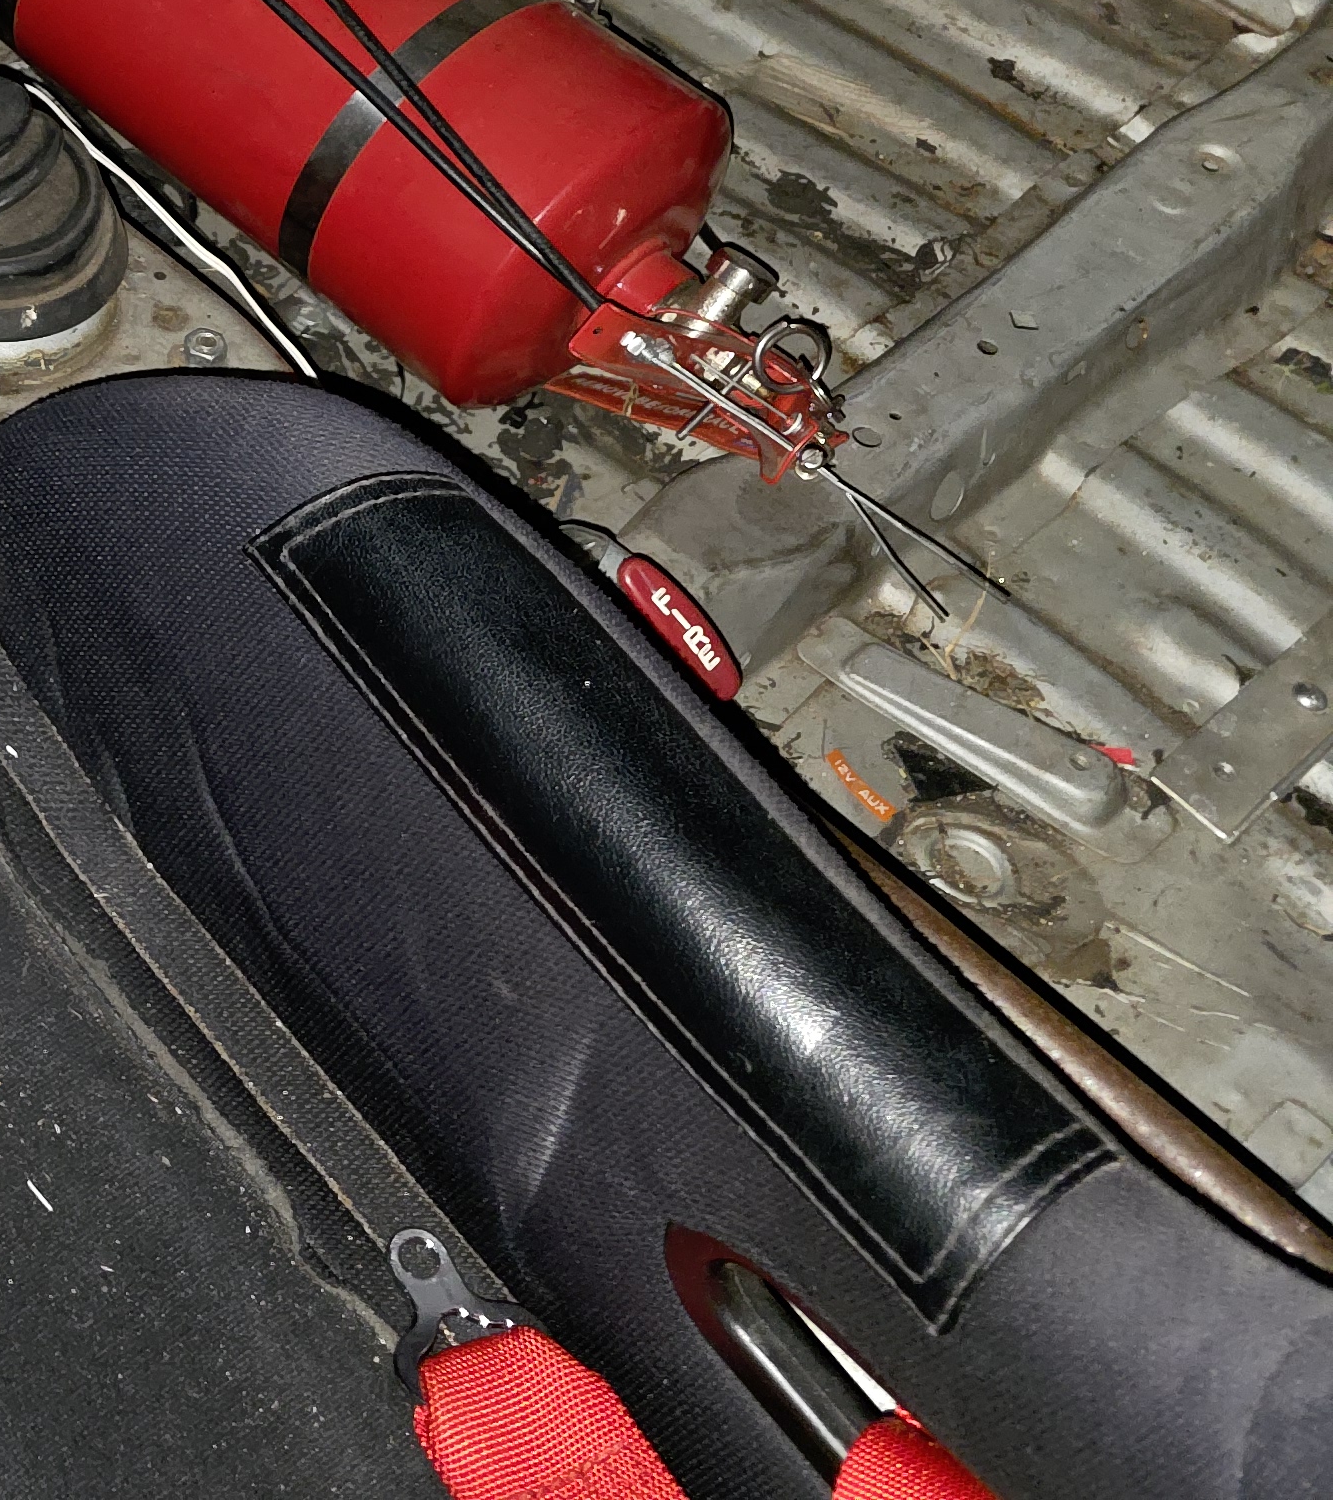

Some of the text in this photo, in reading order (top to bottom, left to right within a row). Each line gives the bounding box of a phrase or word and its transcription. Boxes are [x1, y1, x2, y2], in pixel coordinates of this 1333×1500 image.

[651, 586, 721, 672] FIRE
[834, 759, 890, 815] 12V AUX
